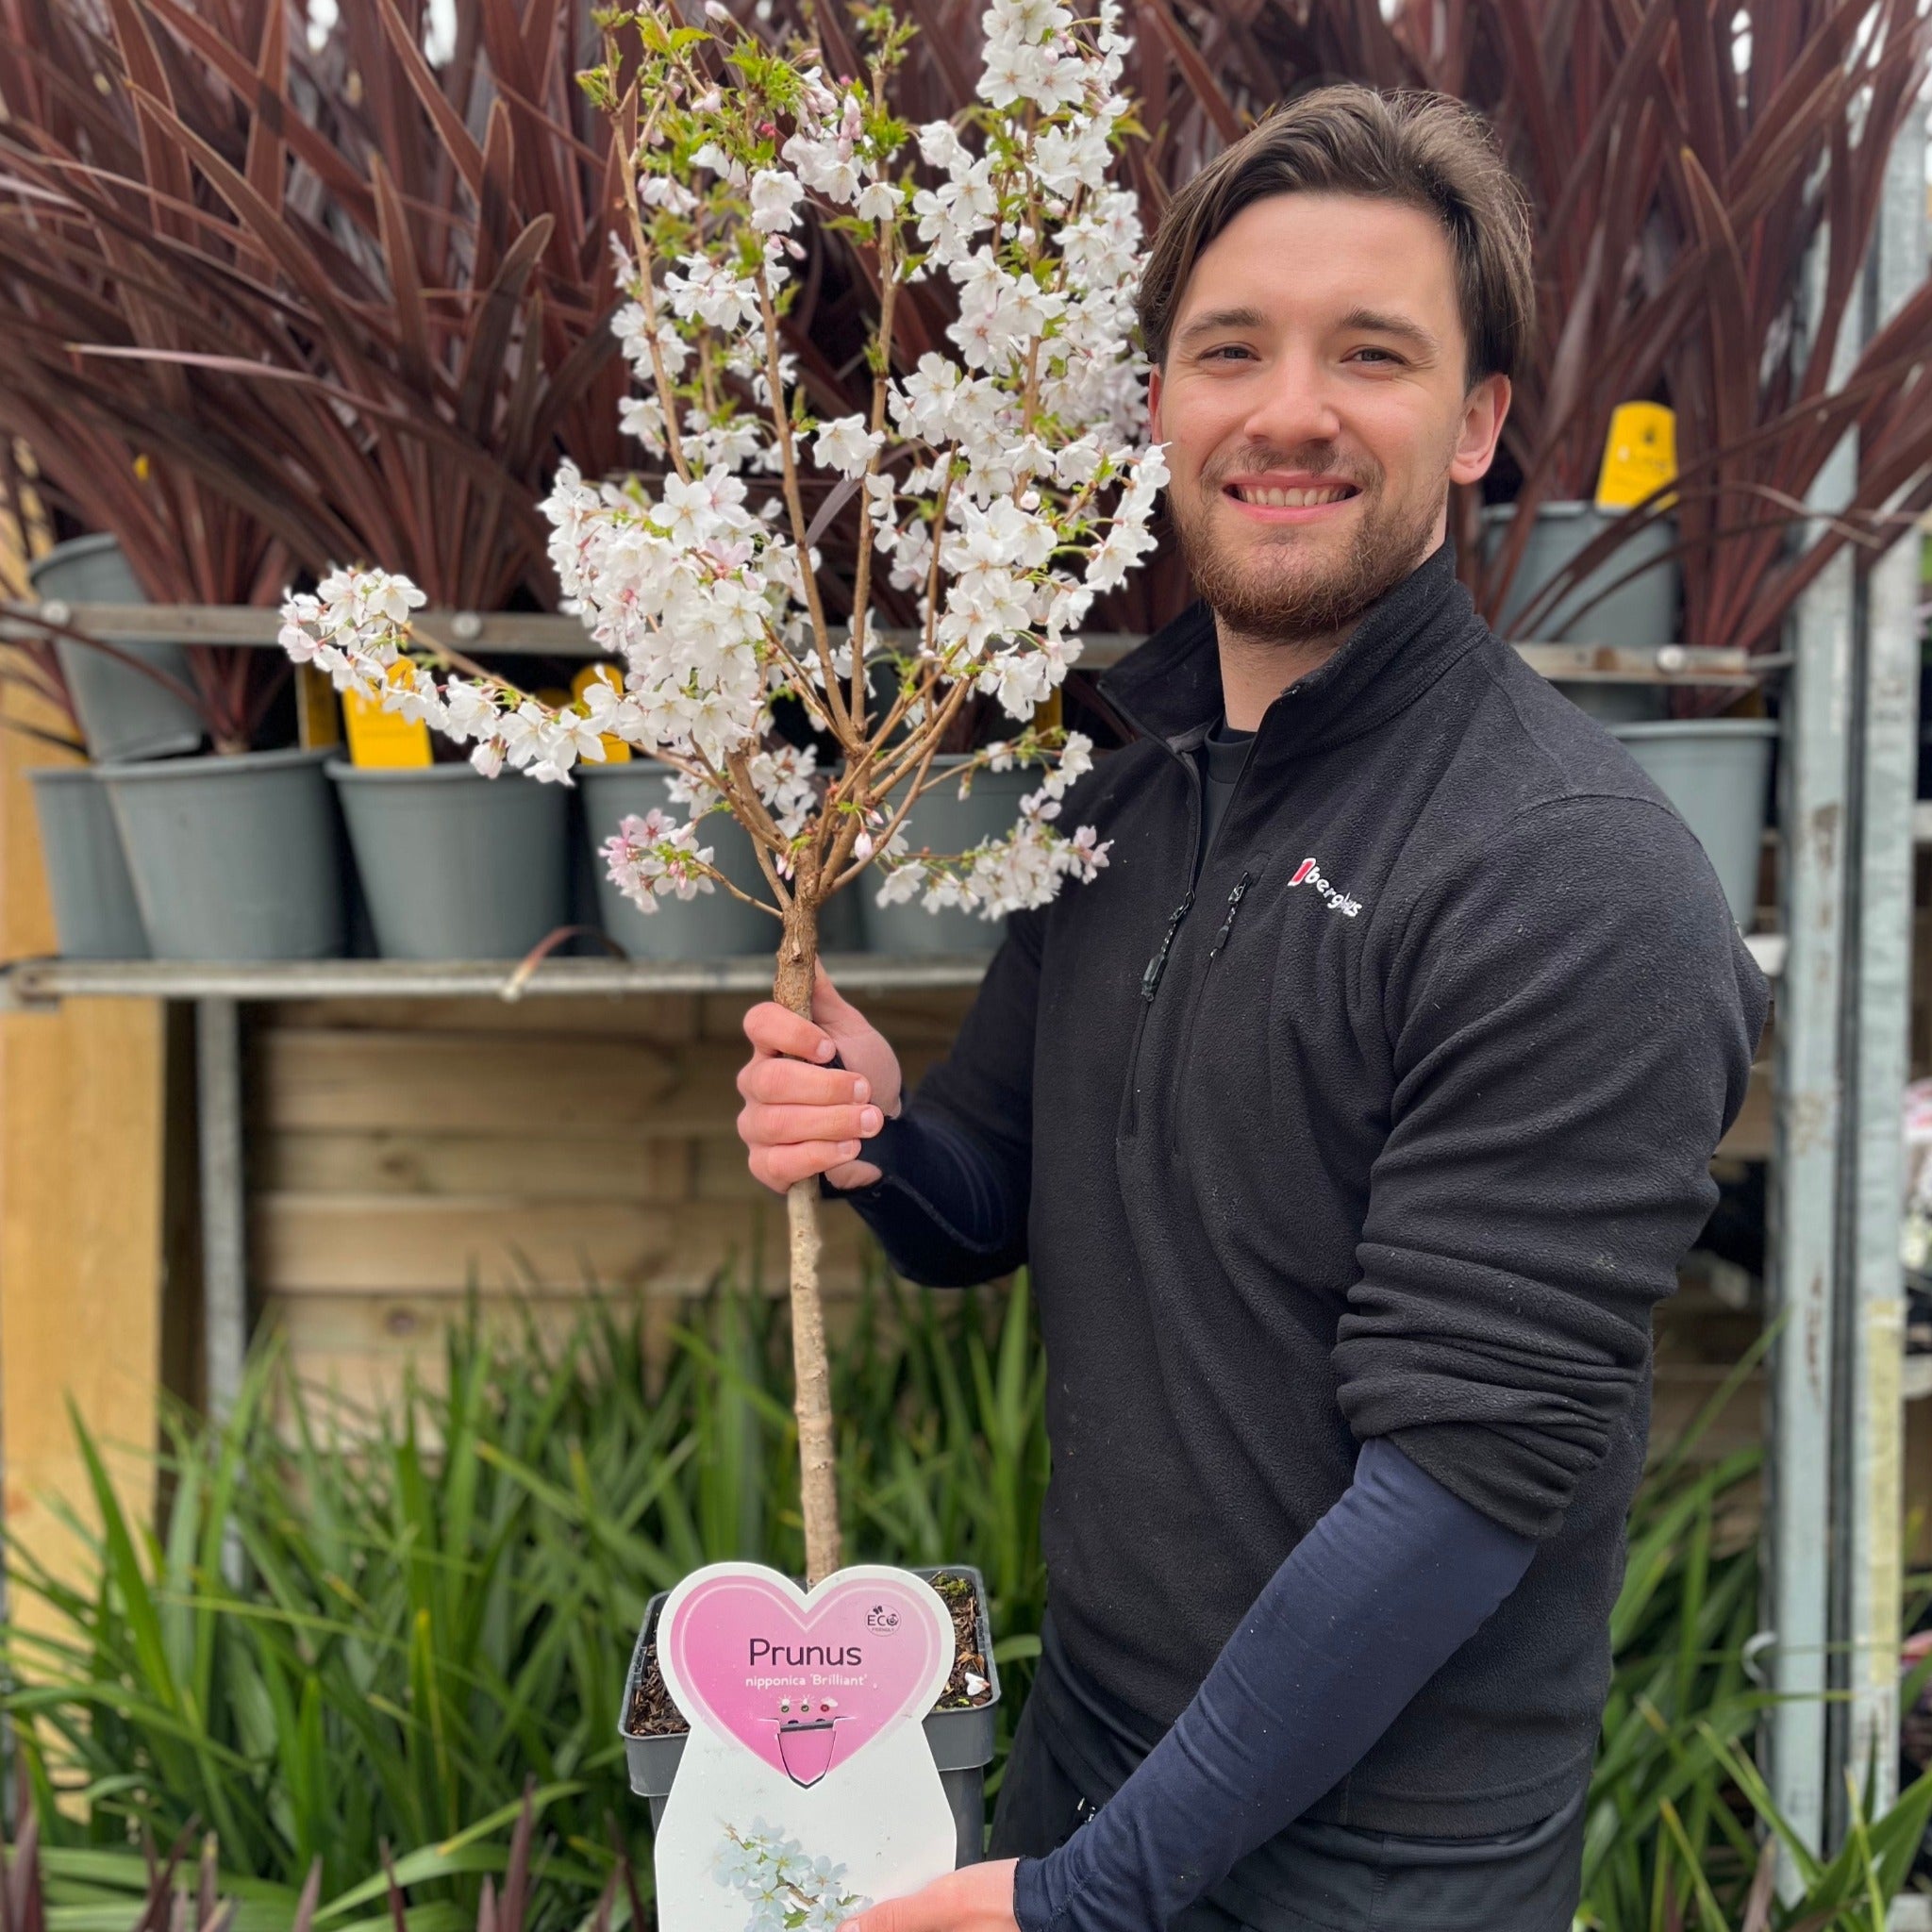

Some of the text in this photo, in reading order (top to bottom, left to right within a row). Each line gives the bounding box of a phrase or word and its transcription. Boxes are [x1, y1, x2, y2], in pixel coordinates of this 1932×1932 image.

[867, 1613, 899, 1626] ECO
[749, 1638, 863, 1666] Prunus
[745, 1675, 807, 1690] nipponica
